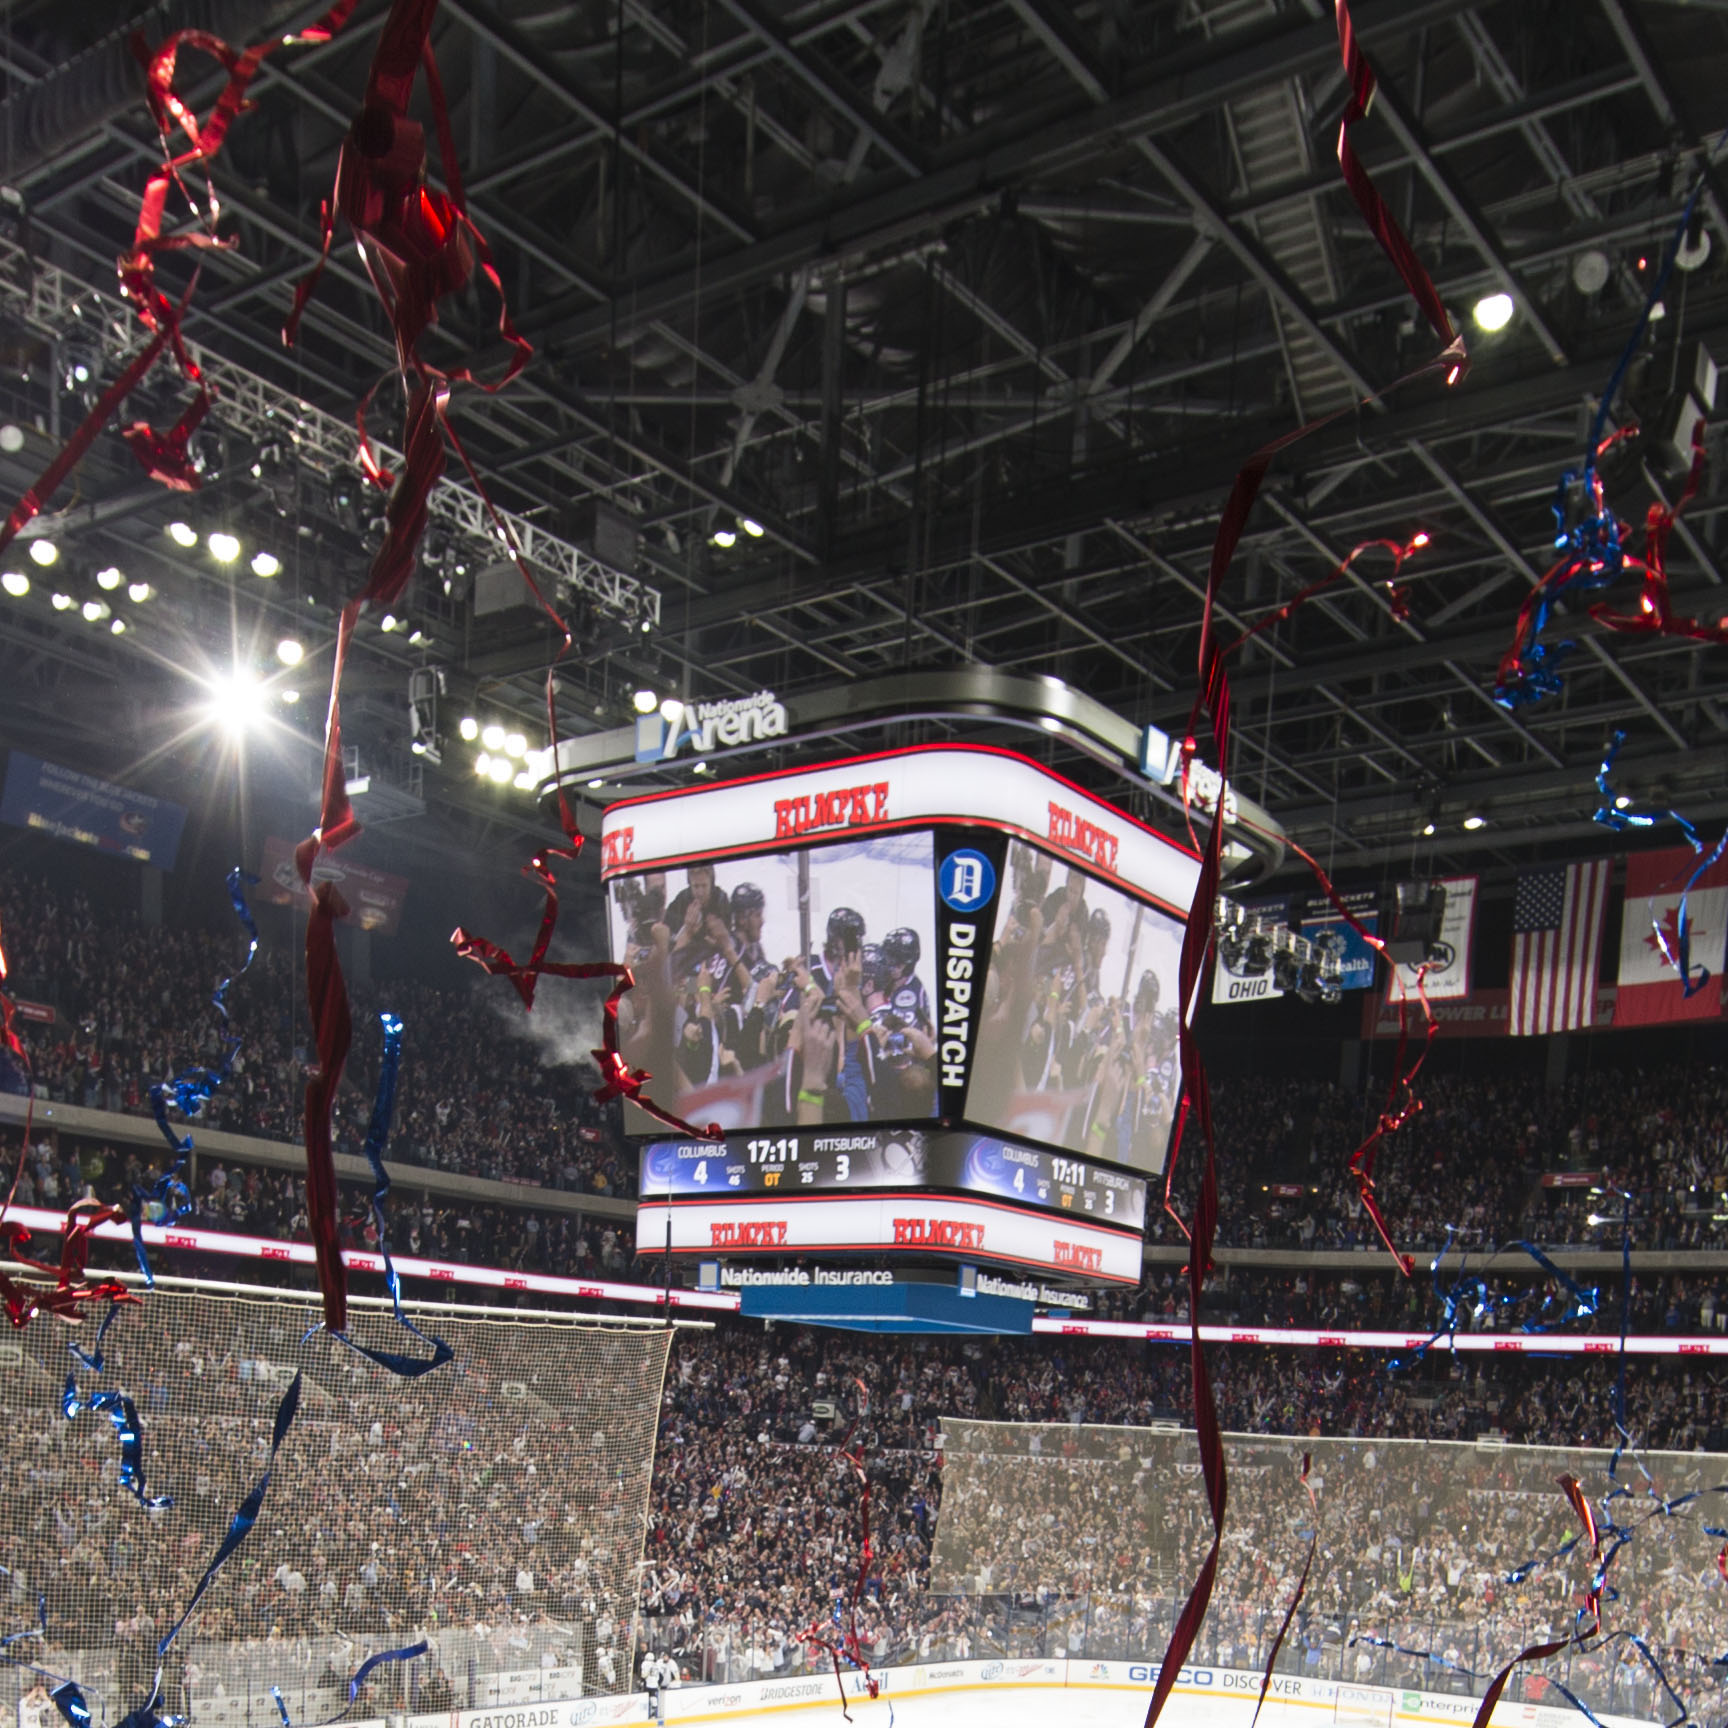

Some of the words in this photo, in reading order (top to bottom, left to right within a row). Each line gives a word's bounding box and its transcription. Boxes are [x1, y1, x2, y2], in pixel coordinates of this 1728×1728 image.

[698, 690, 775, 720] Nationwide
[663, 701, 788, 759] Arena
[774, 781, 889, 838] RUMPKE
[1048, 800, 1119, 874] RUMPKE
[1229, 979, 1268, 999] OHIO
[941, 922, 976, 1087] DISPATCH
[677, 1144, 727, 1160] COLUMBUS
[748, 1138, 799, 1163] 17:11
[813, 1136, 876, 1152] PITTSBURGH
[835, 1155, 850, 1182] 3
[1002, 1146, 1039, 1168] COLUMBUS
[693, 1160, 708, 1185] 4
[764, 1173, 780, 1187] OT
[1013, 1168, 1025, 1194] 4
[1052, 1158, 1086, 1187] 17:11
[1092, 1170, 1130, 1192] PITTSBURGH
[1104, 1191, 1116, 1215] 3
[710, 1221, 788, 1247] RUMPKE
[893, 1218, 985, 1249] RUMPKE
[1054, 1240, 1103, 1272] RUMPKE
[721, 1267, 809, 1287] Nationwide
[814, 1266, 894, 1287] Insurance
[976, 1272, 1038, 1301] Nationwide
[1040, 1281, 1089, 1309] Insurance
[851, 1671, 889, 1694] Ail
[1128, 1665, 1214, 1686] GECO
[1223, 1673, 1302, 1695] DISCOVER
[708, 1694, 742, 1708] verizon
[760, 1683, 824, 1701] BRIDGESTONE
